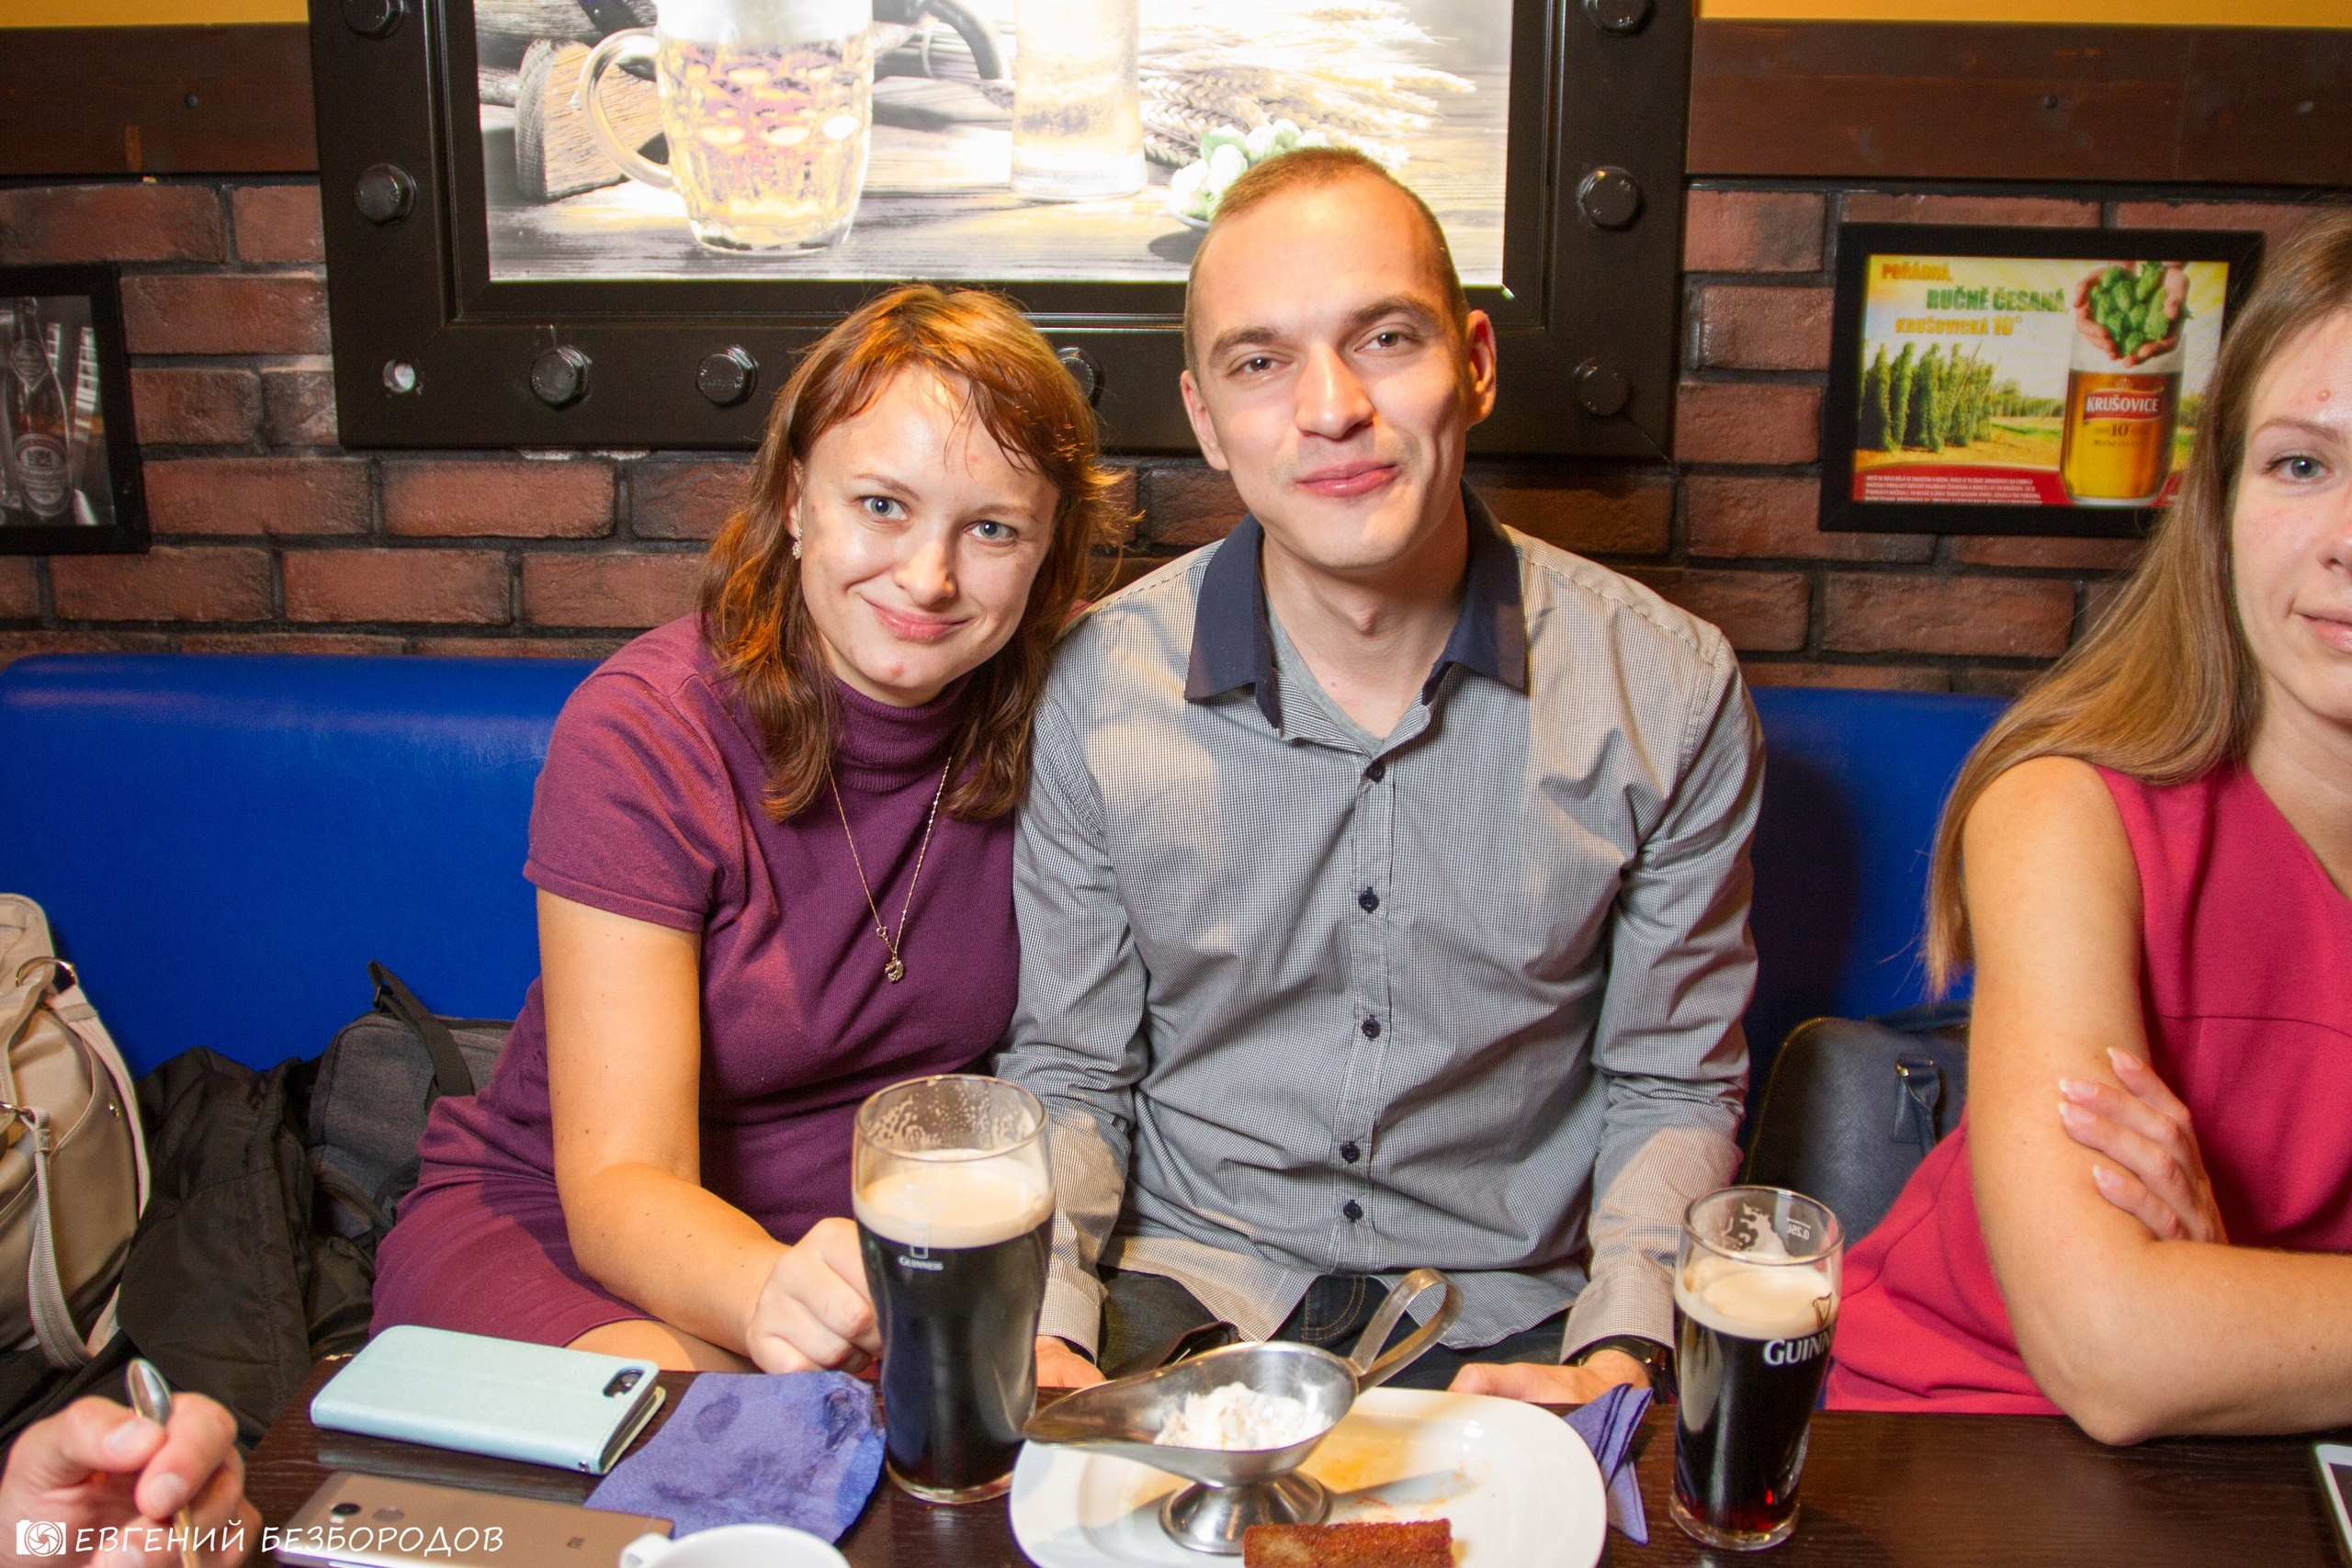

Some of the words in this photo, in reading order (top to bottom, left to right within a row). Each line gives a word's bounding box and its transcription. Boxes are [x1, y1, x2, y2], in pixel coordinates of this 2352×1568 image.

[1927, 286, 1989, 310] RUČNĚ
[1895, 315, 1988, 334] KRUŠOVICKÁ
[2086, 393, 2159, 412] KRUŠOVICE
[899, 1255, 944, 1270] GUINNESS
